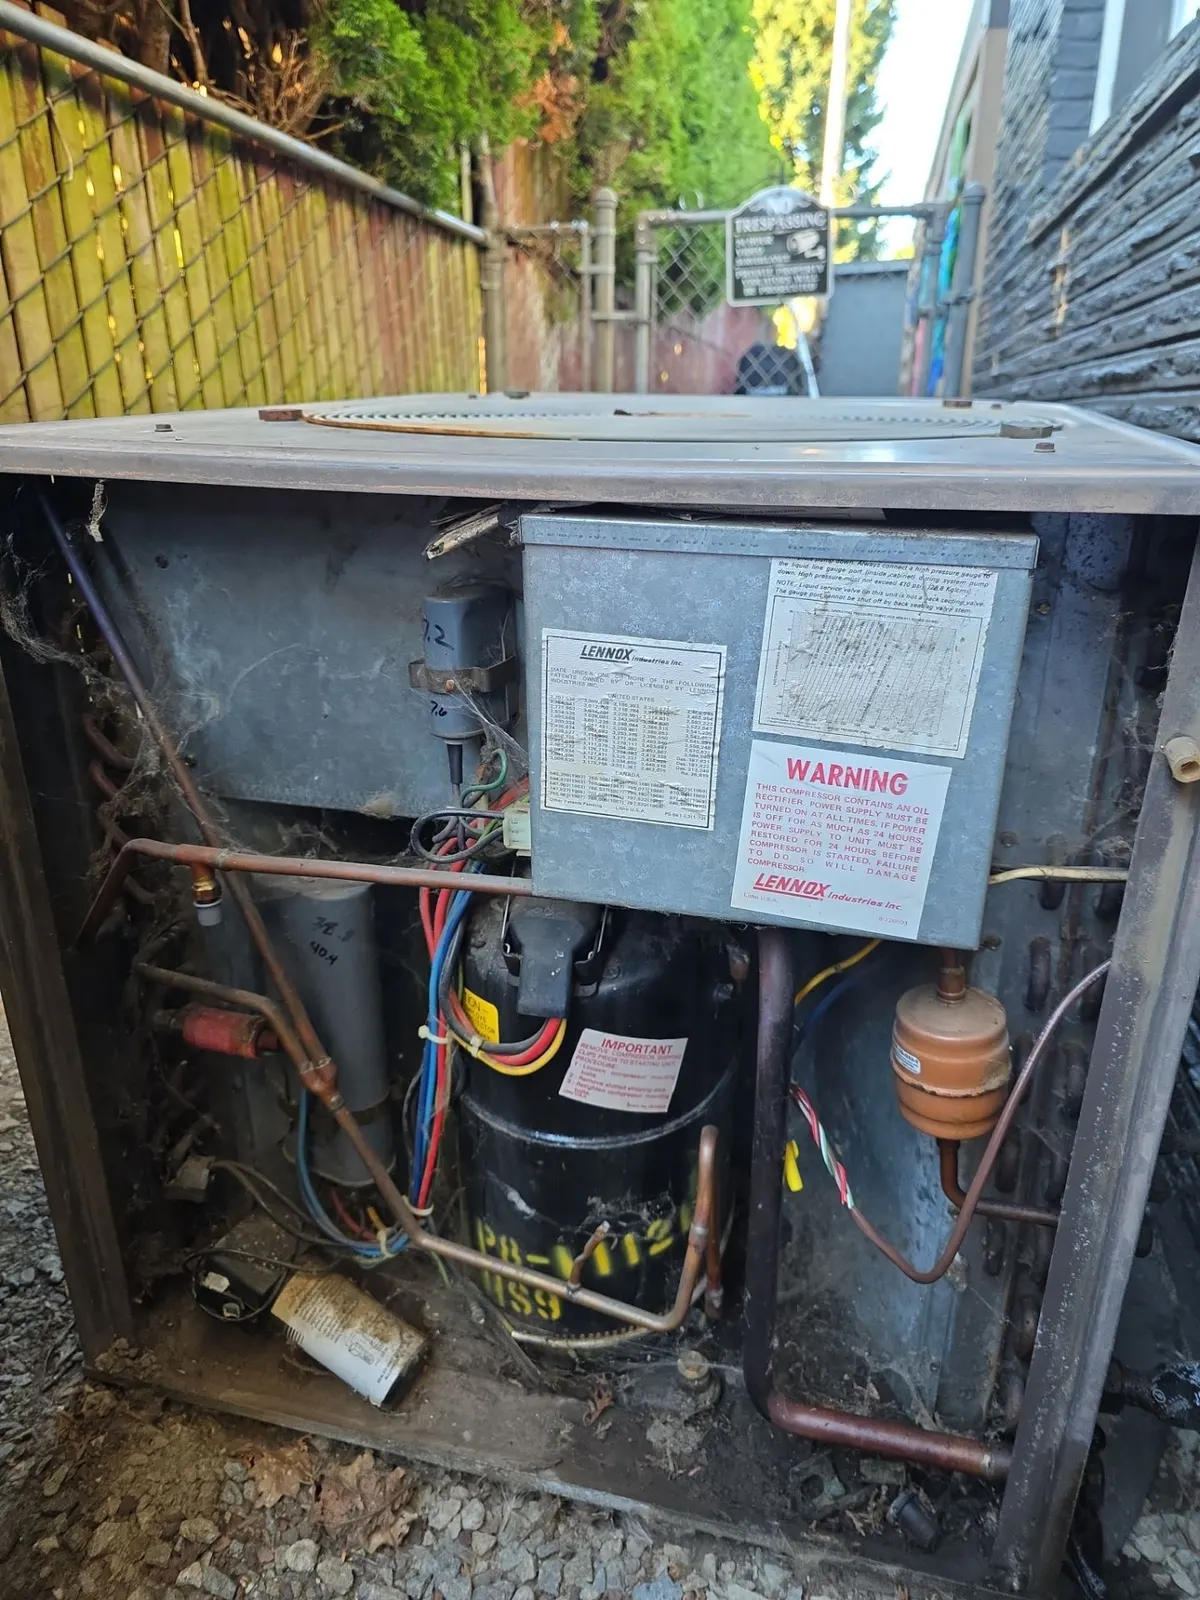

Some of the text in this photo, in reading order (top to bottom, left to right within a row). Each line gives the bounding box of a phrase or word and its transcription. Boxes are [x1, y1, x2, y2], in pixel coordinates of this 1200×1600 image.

[736, 211, 827, 232] TRESPASSING
[918, 575, 939, 583] during
[582, 645, 633, 660] LENNOX
[550, 672, 576, 680] PATENTS
[550, 678, 585, 686] INDUSTRIES
[678, 680, 715, 689] FOLLOWING
[430, 700, 448, 717] 7.6
[615, 770, 639, 778] CANADA
[788, 759, 906, 794] WARNING
[756, 792, 928, 824] RECTIFIER POWER SUPPLY MUST BE
[757, 782, 929, 815] THIS COMPRESSOR CONTAINS AN OIL
[754, 802, 791, 813] TURNED
[794, 808, 807, 816] ON
[826, 813, 844, 822] ALL
[848, 816, 877, 827] TIMES.
[892, 823, 925, 834] POWER
[752, 820, 782, 830] POWER
[788, 827, 822, 837] SUPPLY
[848, 835, 871, 845] UNIT
[877, 841, 904, 850] MUST
[765, 813, 783, 821] OFF
[788, 817, 805, 825] FOR
[810, 820, 822, 828] AS
[826, 823, 853, 832] MUCH
[888, 832, 923, 844] HOURS,
[750, 839, 807, 853] COMPRESSOR
[826, 852, 870, 864] STARTED.
[876, 860, 917, 872] FAILURE
[751, 830, 797, 843] RESTORED
[804, 838, 822, 847] FOR
[844, 845, 876, 856] HOURS
[882, 851, 920, 863] BEFORE
[748, 858, 804, 872] COMPRESSOR.
[749, 848, 916, 881] TO DO SO WILL DAMAGE
[756, 874, 829, 896] LENNOX
[828, 892, 882, 906] Industries
[310, 941, 339, 965] 40.4
[579, 1042, 609, 1054] REMOVE
[601, 1038, 673, 1055] IMPORTANT
[576, 1055, 616, 1069] PROCEDURE
[578, 1049, 596, 1058] CLIPS
[598, 1053, 618, 1064] PRIOR
[630, 1058, 660, 1068] STARTING
